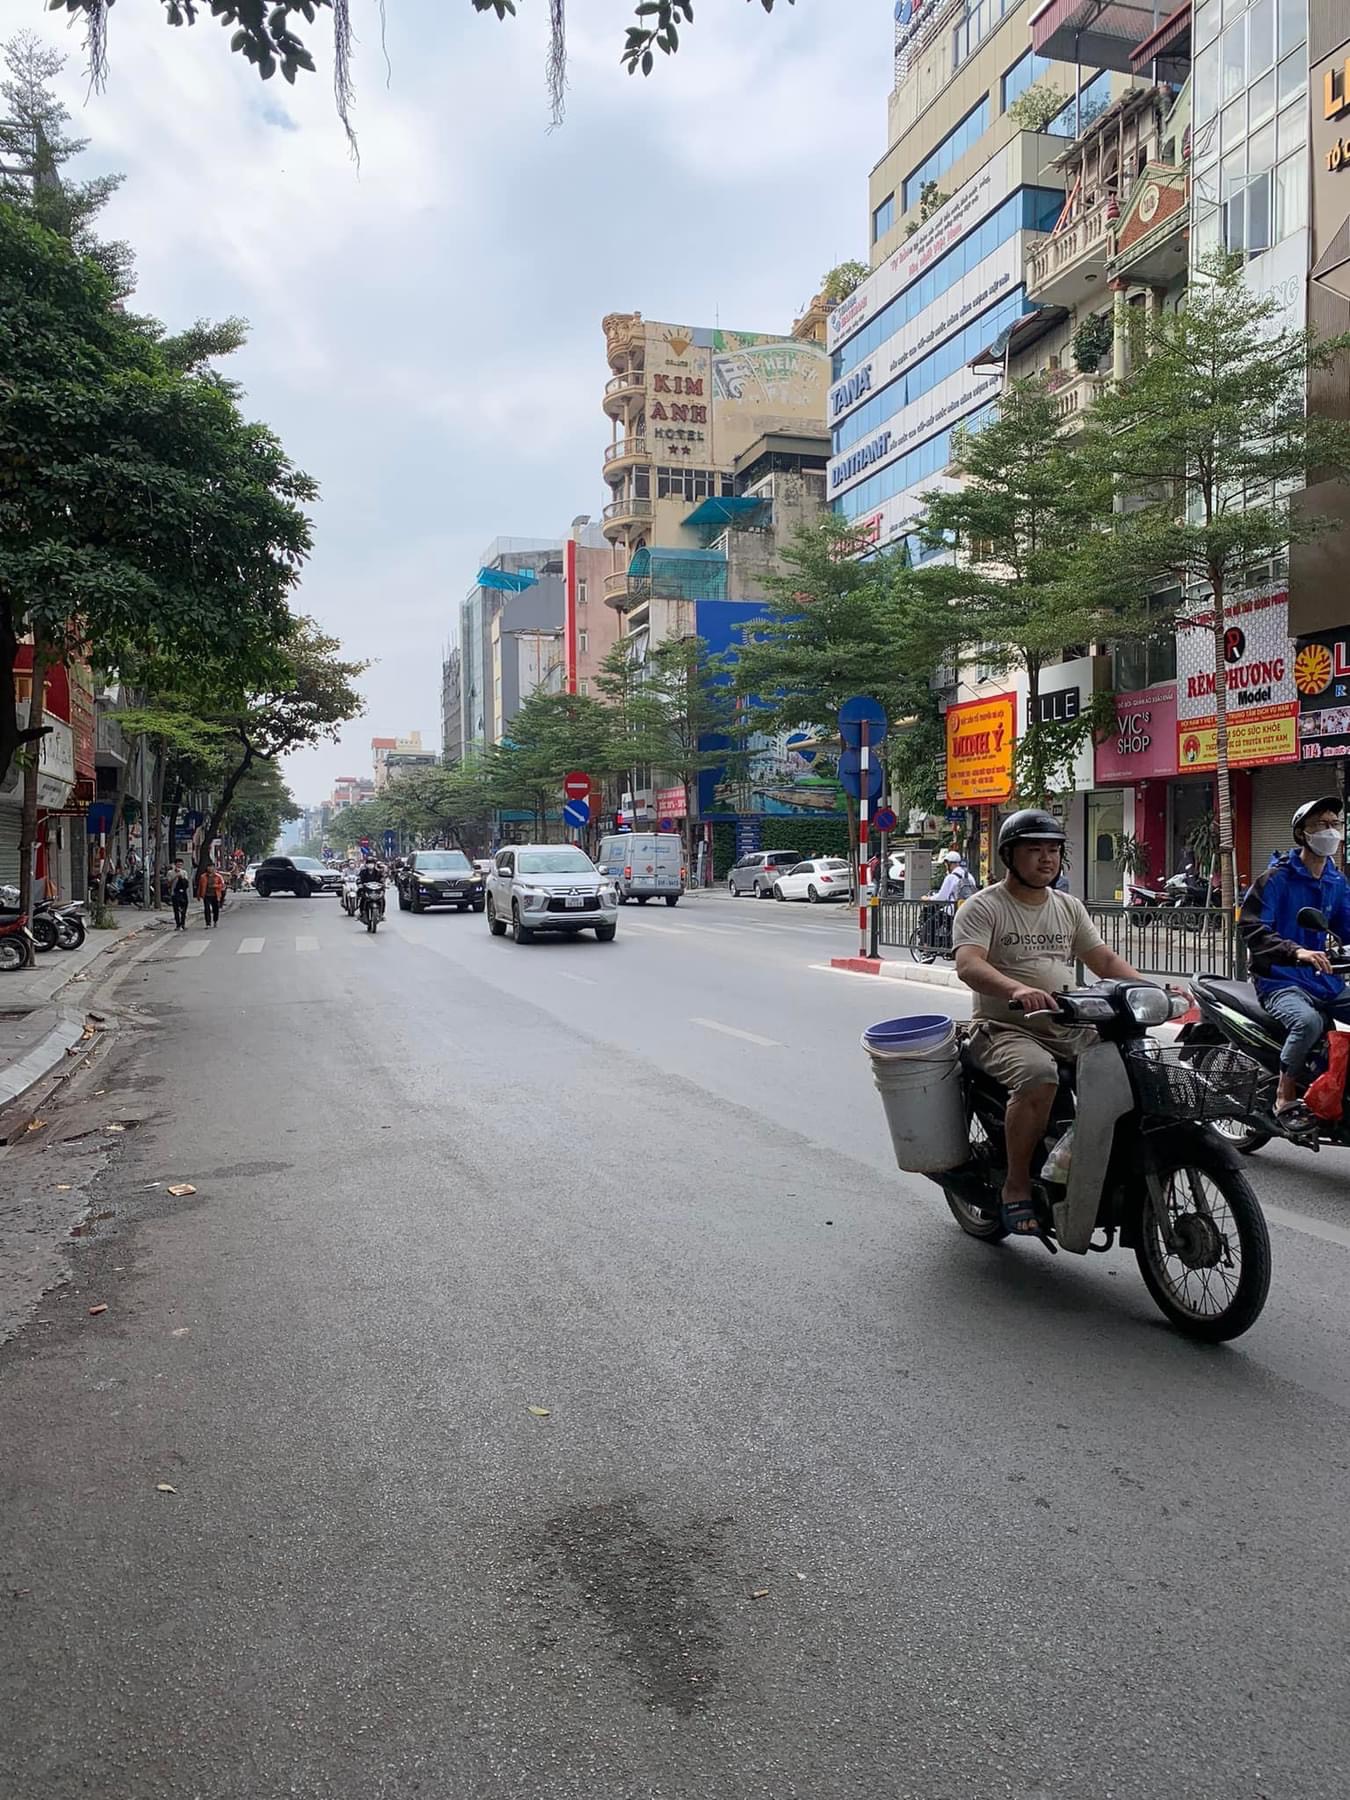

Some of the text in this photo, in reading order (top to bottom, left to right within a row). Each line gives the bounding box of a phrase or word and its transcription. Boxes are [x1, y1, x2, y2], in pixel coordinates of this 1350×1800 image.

[654, 373, 704, 396] KIM
[651, 401, 707, 424] ANH
[654, 427, 705, 442] HOTEL
[1225, 658, 1285, 690] HƯƠNG
[1238, 686, 1271, 705] Model
[1117, 711, 1150, 735] VIC'S
[1117, 736, 1150, 754] SHOP
